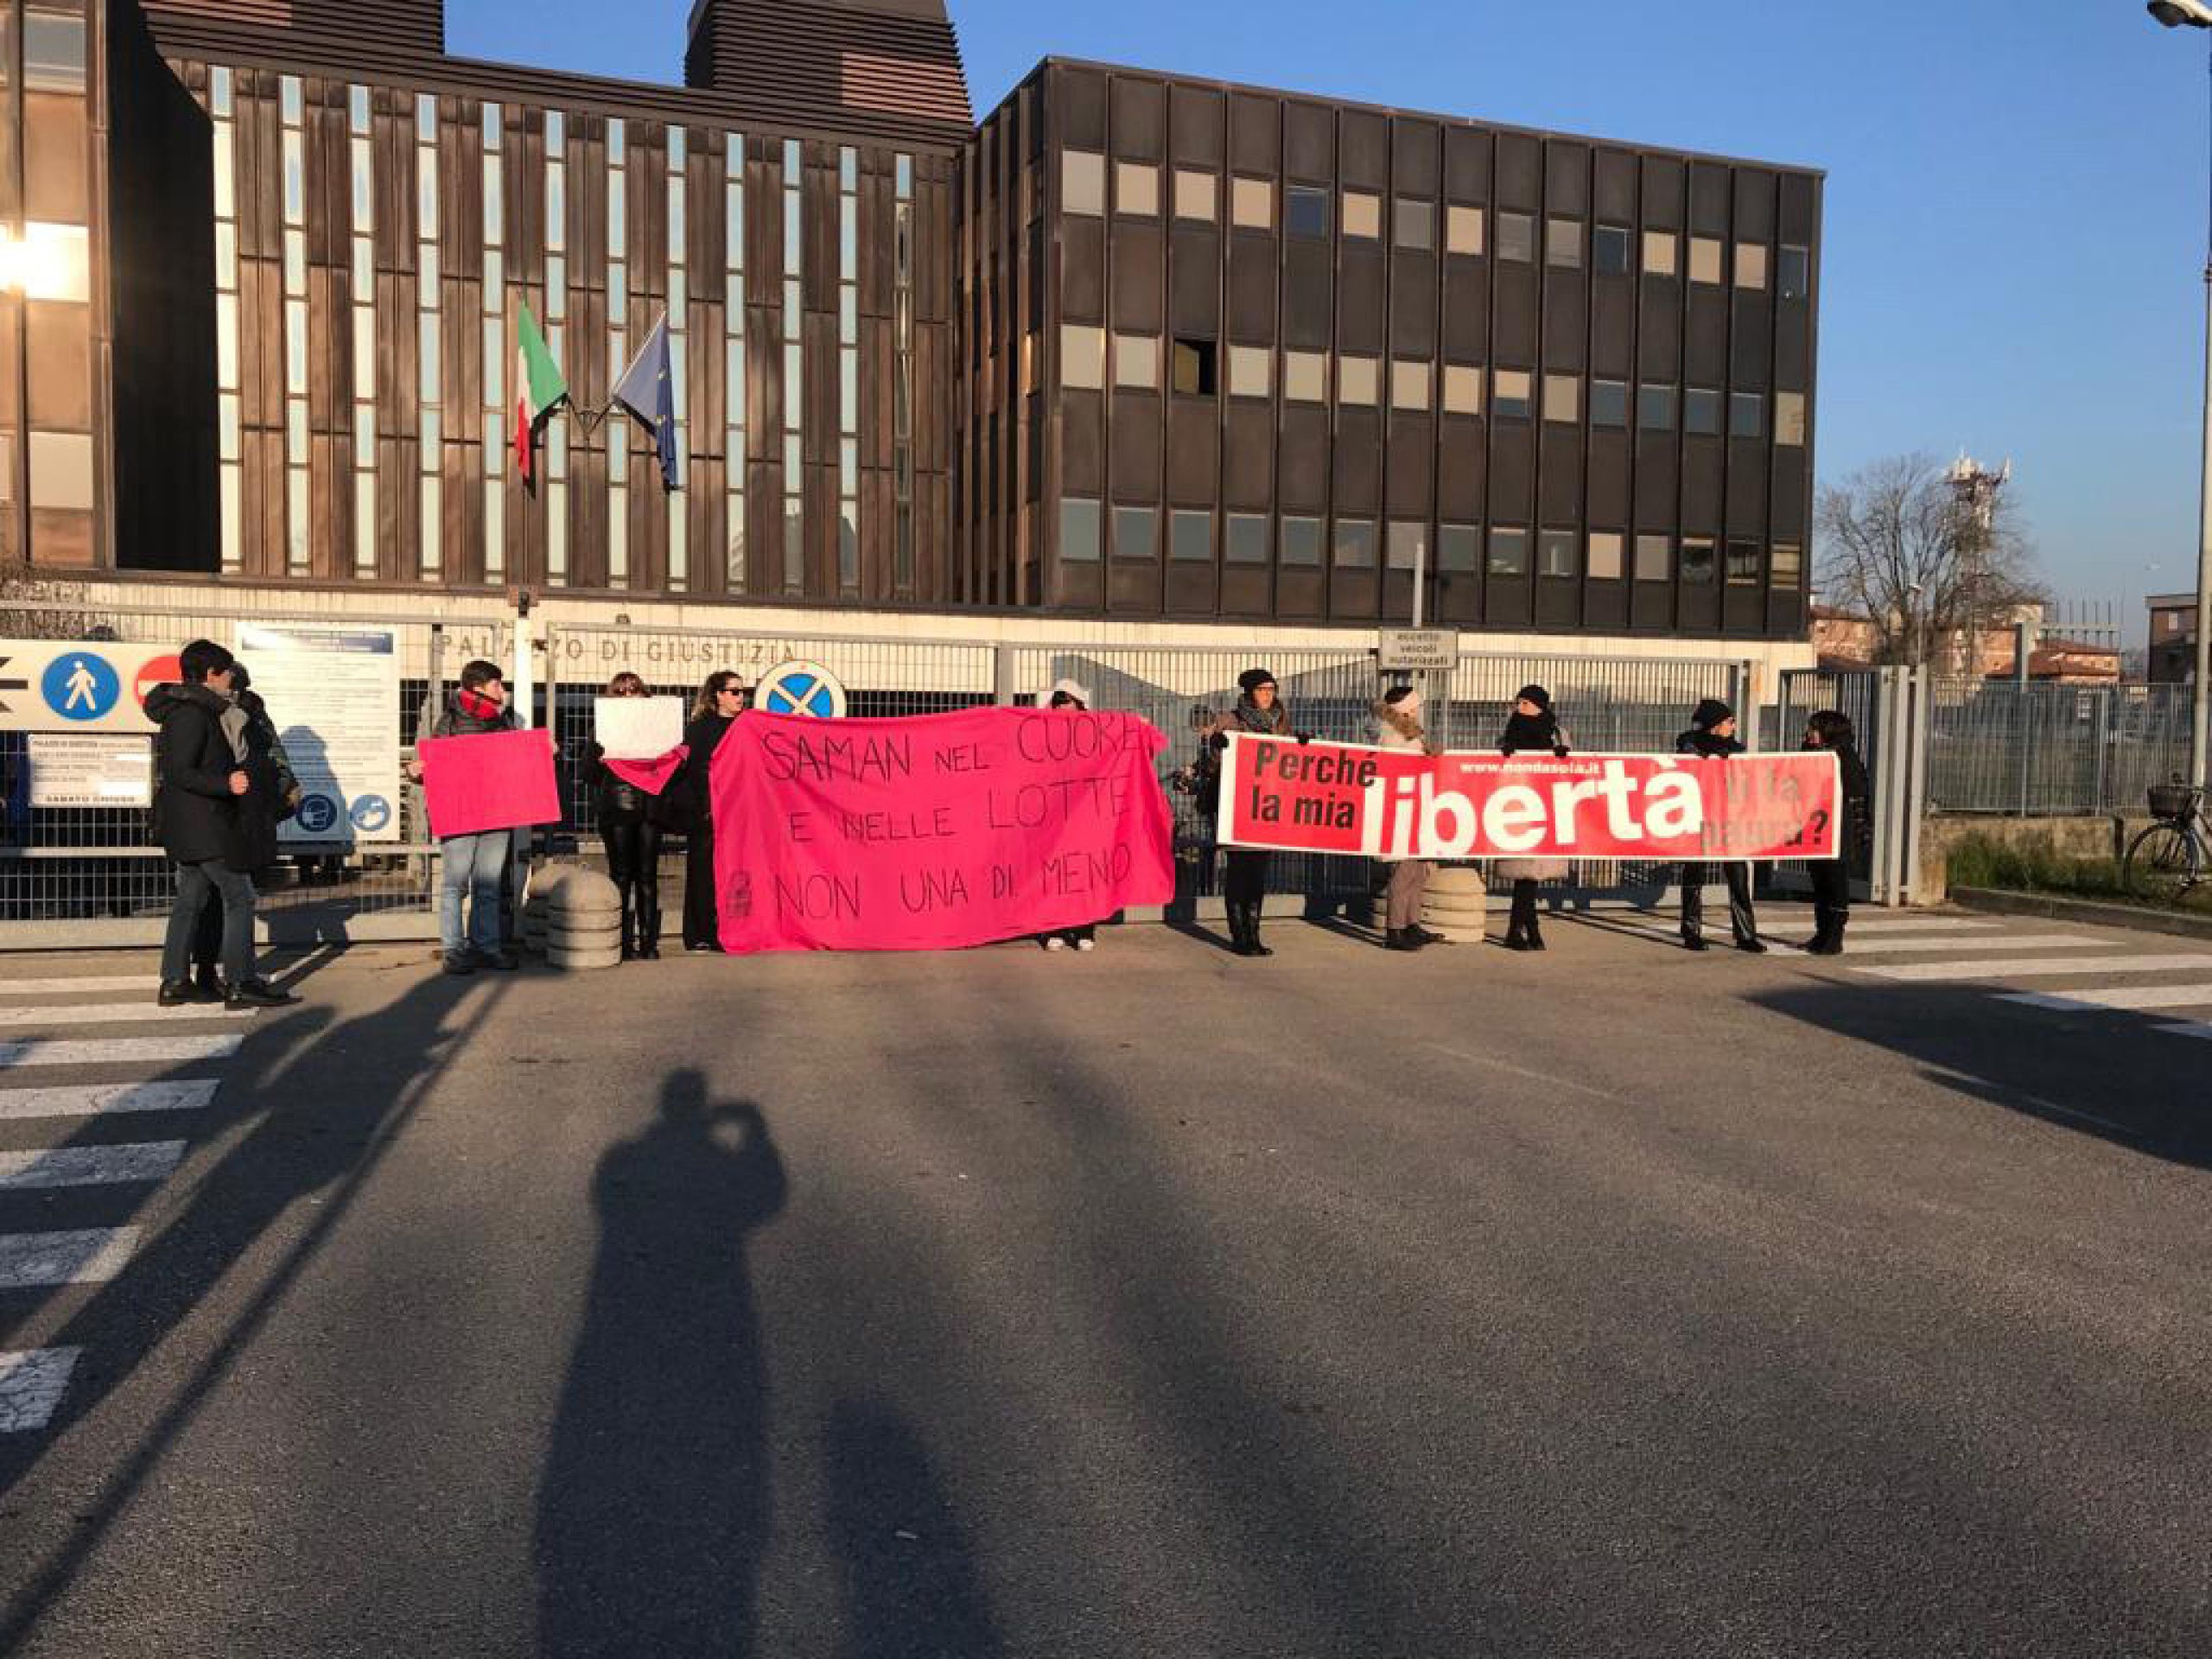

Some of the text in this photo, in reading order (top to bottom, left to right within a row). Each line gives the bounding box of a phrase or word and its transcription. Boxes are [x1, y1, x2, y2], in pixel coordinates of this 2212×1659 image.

[601, 639, 629, 661] DI
[647, 640, 794, 664] GIUSTIZIA
[760, 730, 911, 783] SAMAN
[934, 743, 990, 772] NEL
[1255, 741, 1377, 787] Perché
[787, 775, 1131, 848] E NELLE LOTTE
[1250, 785, 1357, 830] la mia
[1360, 753, 1704, 856] libertà
[774, 871, 861, 919] NON
[899, 867, 969, 913] UNA
[1041, 842, 1131, 897] MENO
